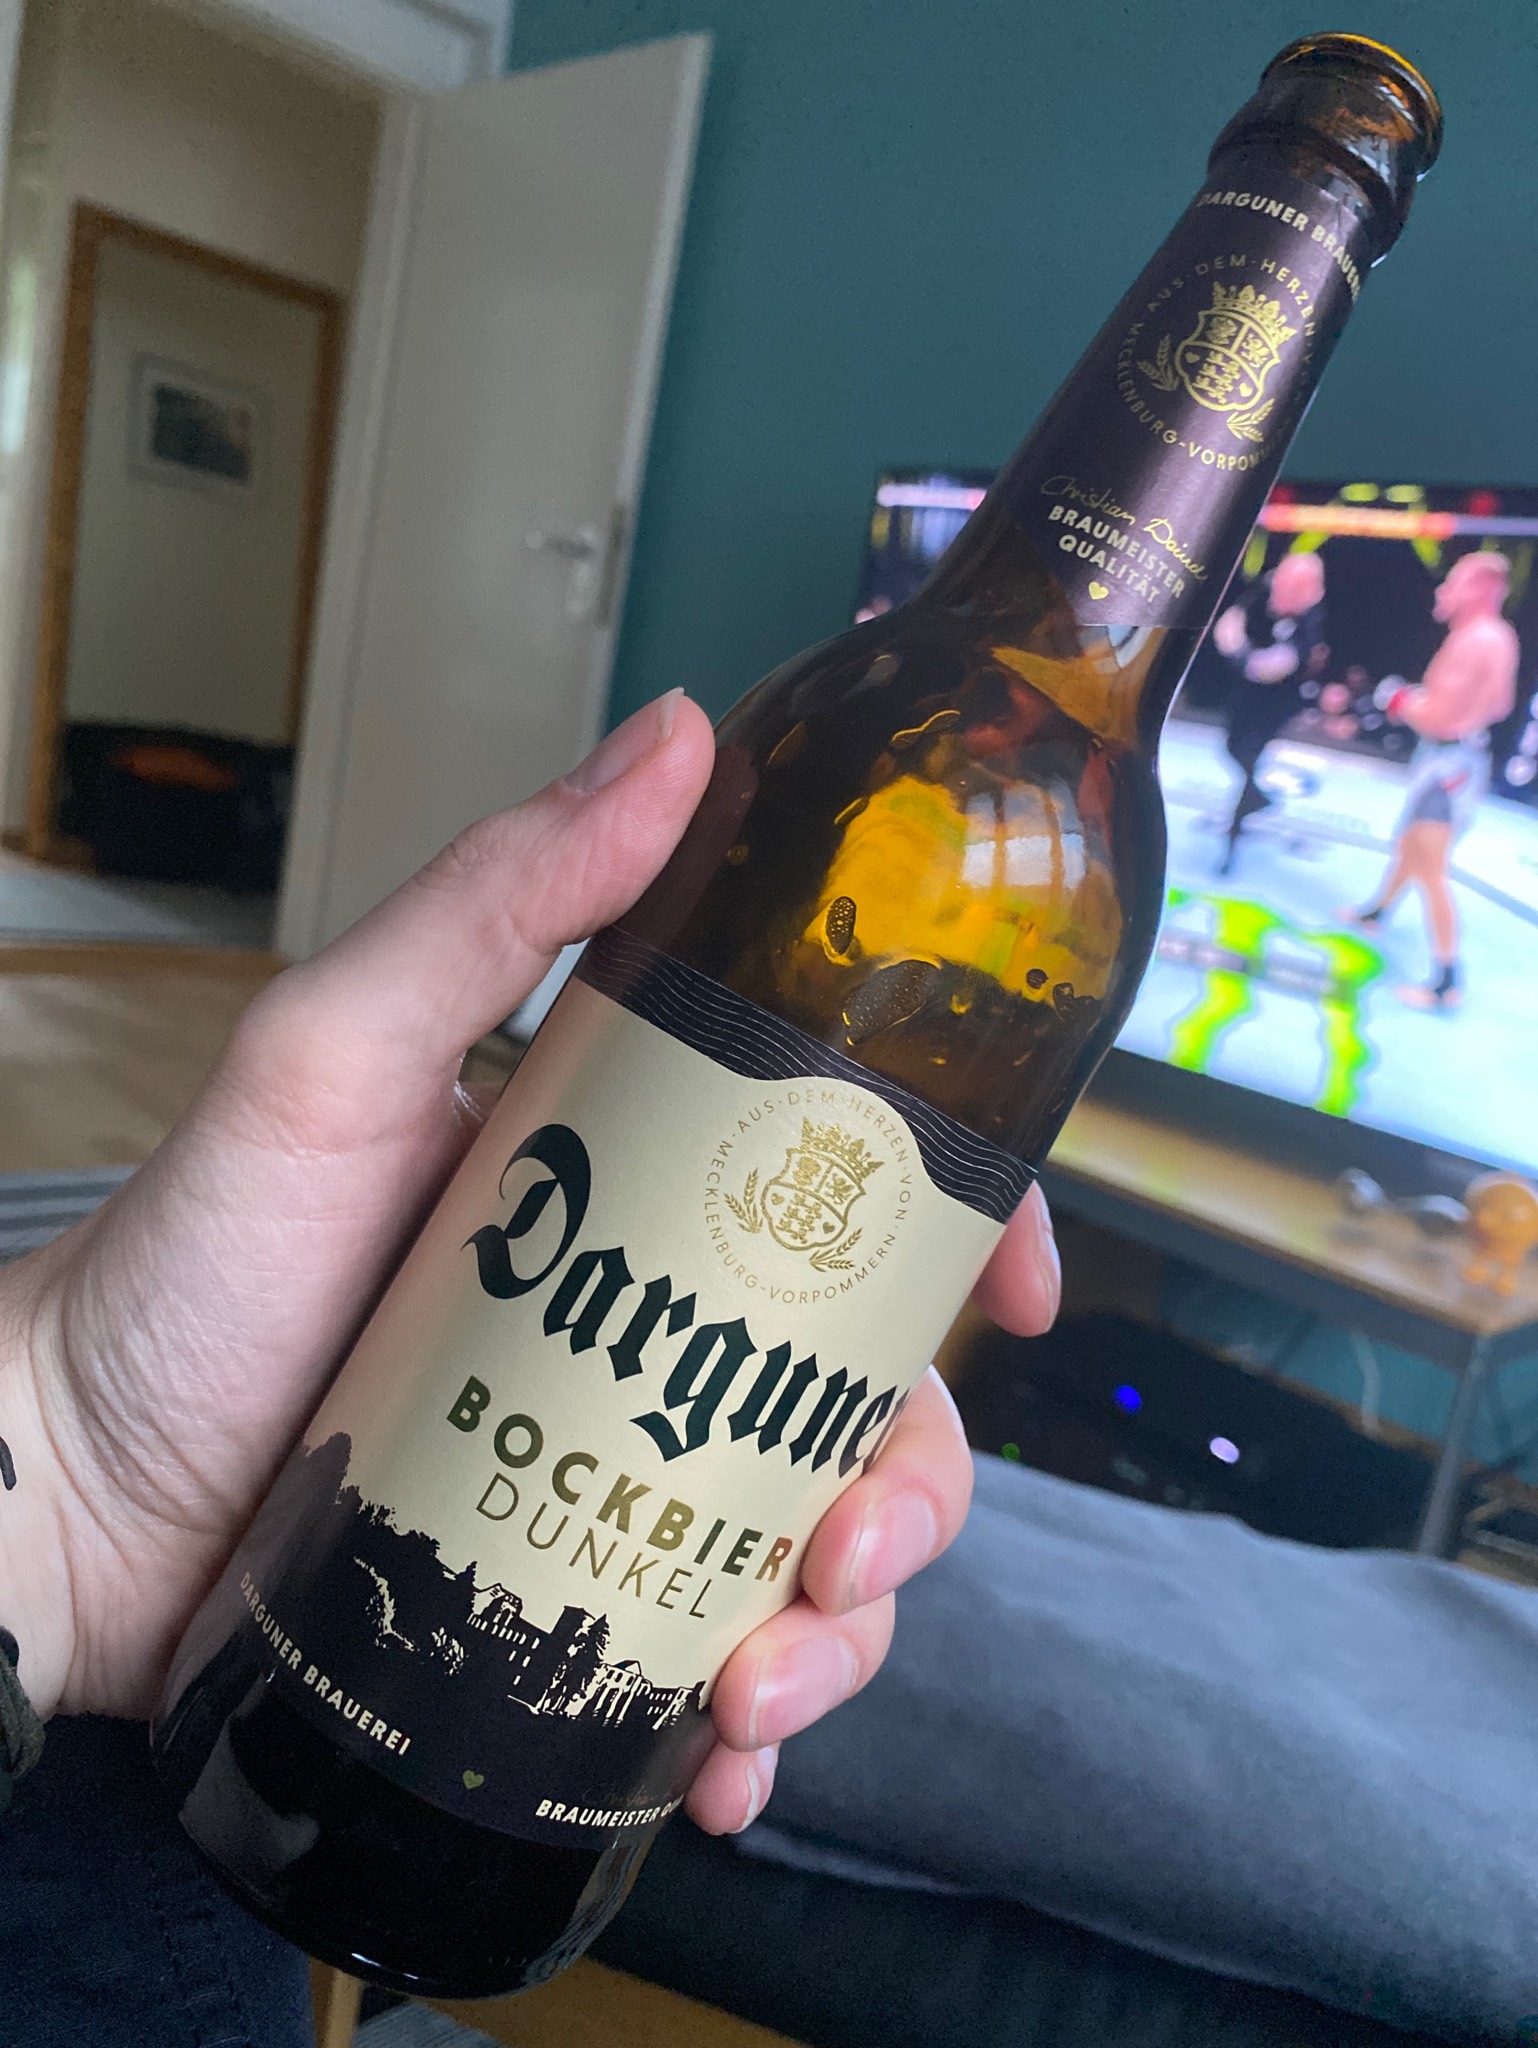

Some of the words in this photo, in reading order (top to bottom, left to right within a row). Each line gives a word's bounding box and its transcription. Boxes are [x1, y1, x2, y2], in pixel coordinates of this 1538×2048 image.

[1195, 254, 1246, 276] DEM
[1260, 258, 1315, 337] HERZEN
[1048, 505, 1186, 598] BRAUMEISTER
[1059, 535, 1161, 603] QUALITÄT
[737, 1100, 775, 1133] AUS
[788, 1089, 835, 1106] DEM
[850, 1097, 909, 1163] HERZEN
[895, 1174, 912, 1221] VON
[446, 1375, 793, 1582] BOCKBIER
[476, 1473, 713, 1619] DUNKEL
[241, 1572, 302, 1670] DARGUNER
[303, 1664, 411, 1756] BRAUEREI
[535, 1799, 661, 1827] BRAUMEISTER
